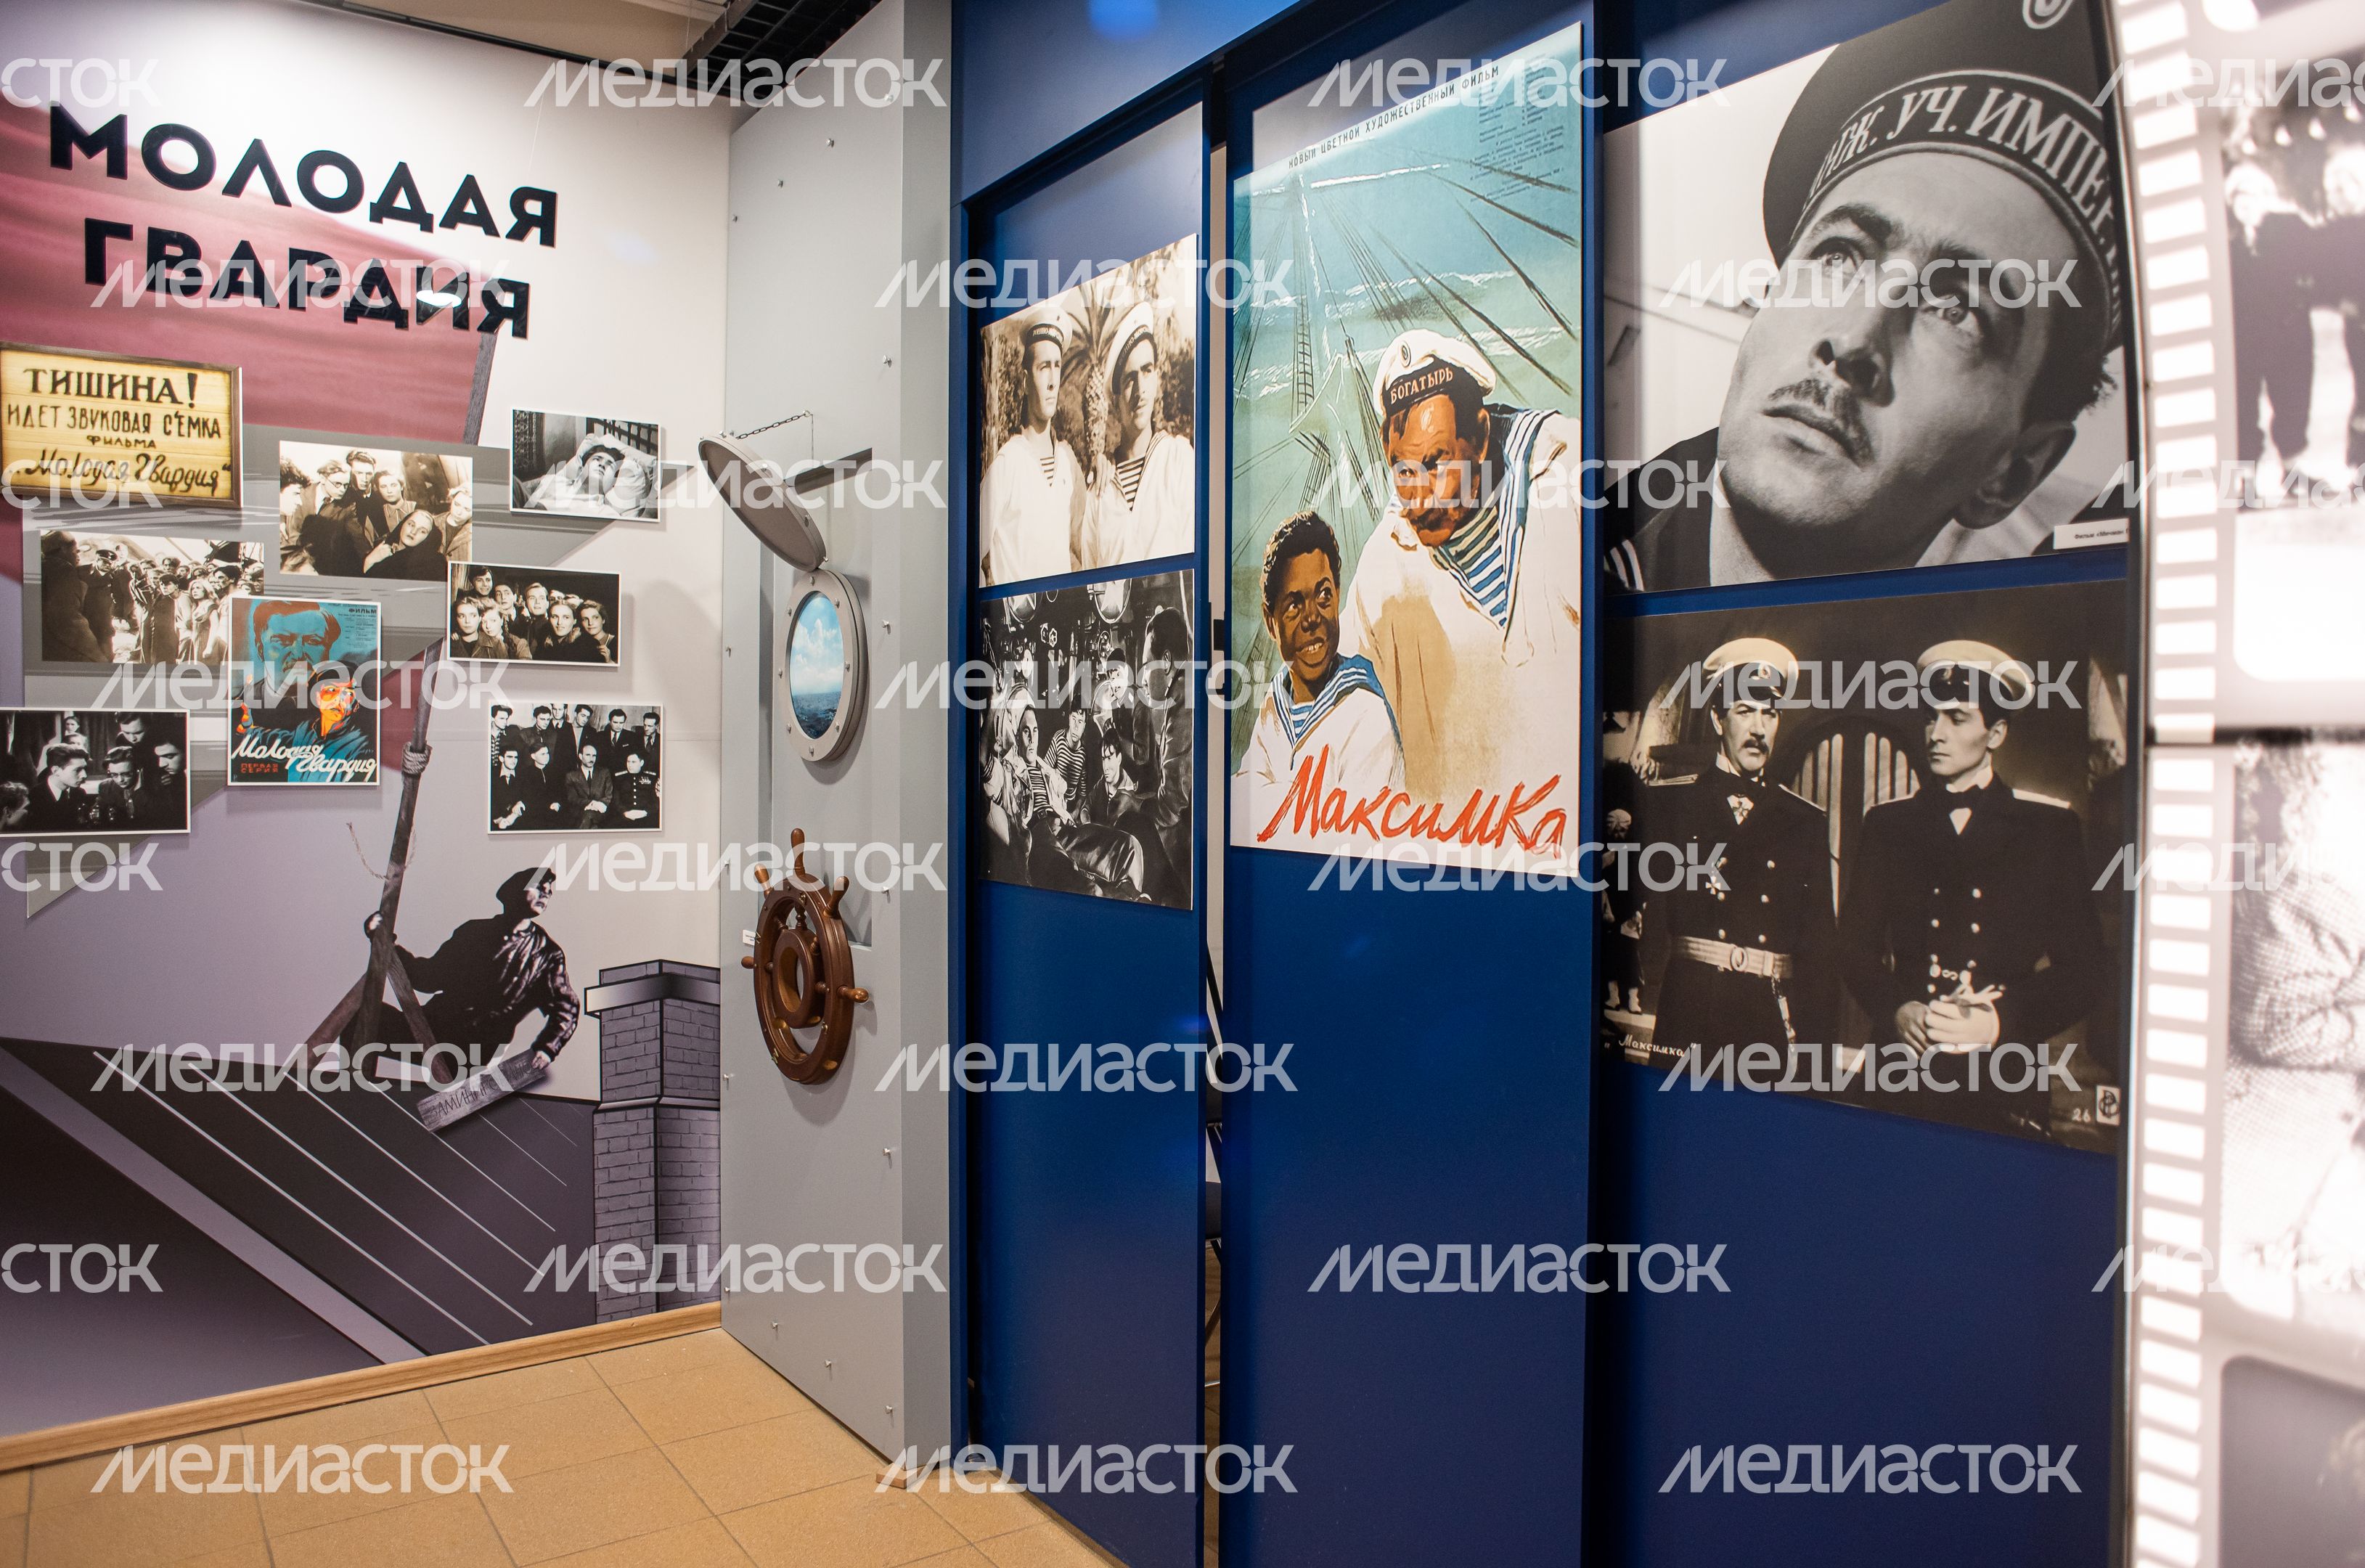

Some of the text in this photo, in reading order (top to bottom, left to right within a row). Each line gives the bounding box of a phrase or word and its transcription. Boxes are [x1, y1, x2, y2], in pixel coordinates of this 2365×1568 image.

[1462, 65, 1499, 90] ФИЛЬМ
[1887, 85, 1967, 140] УЧ.
[49, 100, 557, 248] МОЛОДАЯ
[84, 218, 530, 340] ГВАРДИЯ
[23, 368, 198, 409] ТИШИНА!
[1390, 367, 1453, 404] БОГАТЫРЬ
[8, 403, 62, 428] ИДЕТ
[67, 406, 151, 434] ЗВУКОВАЯ
[231, 734, 324, 769] Молодая
